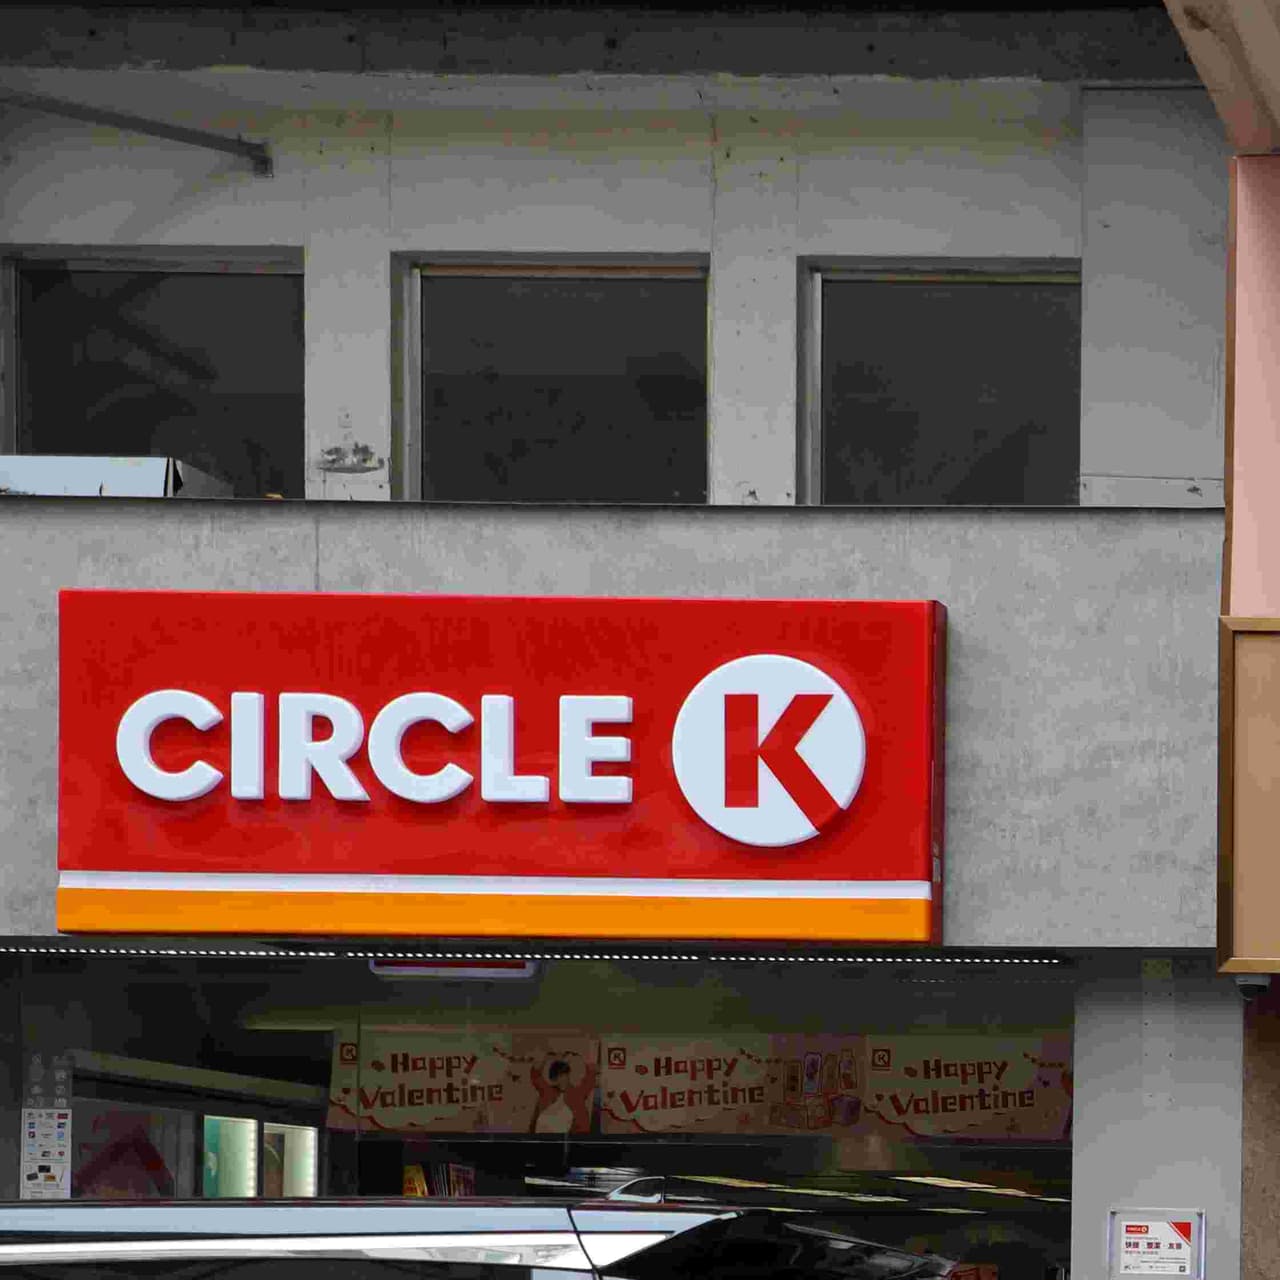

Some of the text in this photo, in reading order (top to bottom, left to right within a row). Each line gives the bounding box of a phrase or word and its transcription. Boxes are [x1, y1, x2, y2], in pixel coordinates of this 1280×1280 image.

[116, 689, 847, 834] CIRCLE K
[391, 1053, 477, 1079] Happy
[654, 1056, 738, 1081] Happy
[923, 1056, 1008, 1085] Happy
[359, 1079, 503, 1109] Valentine
[620, 1081, 765, 1113] Valentine
[889, 1085, 1035, 1115] Valentine
